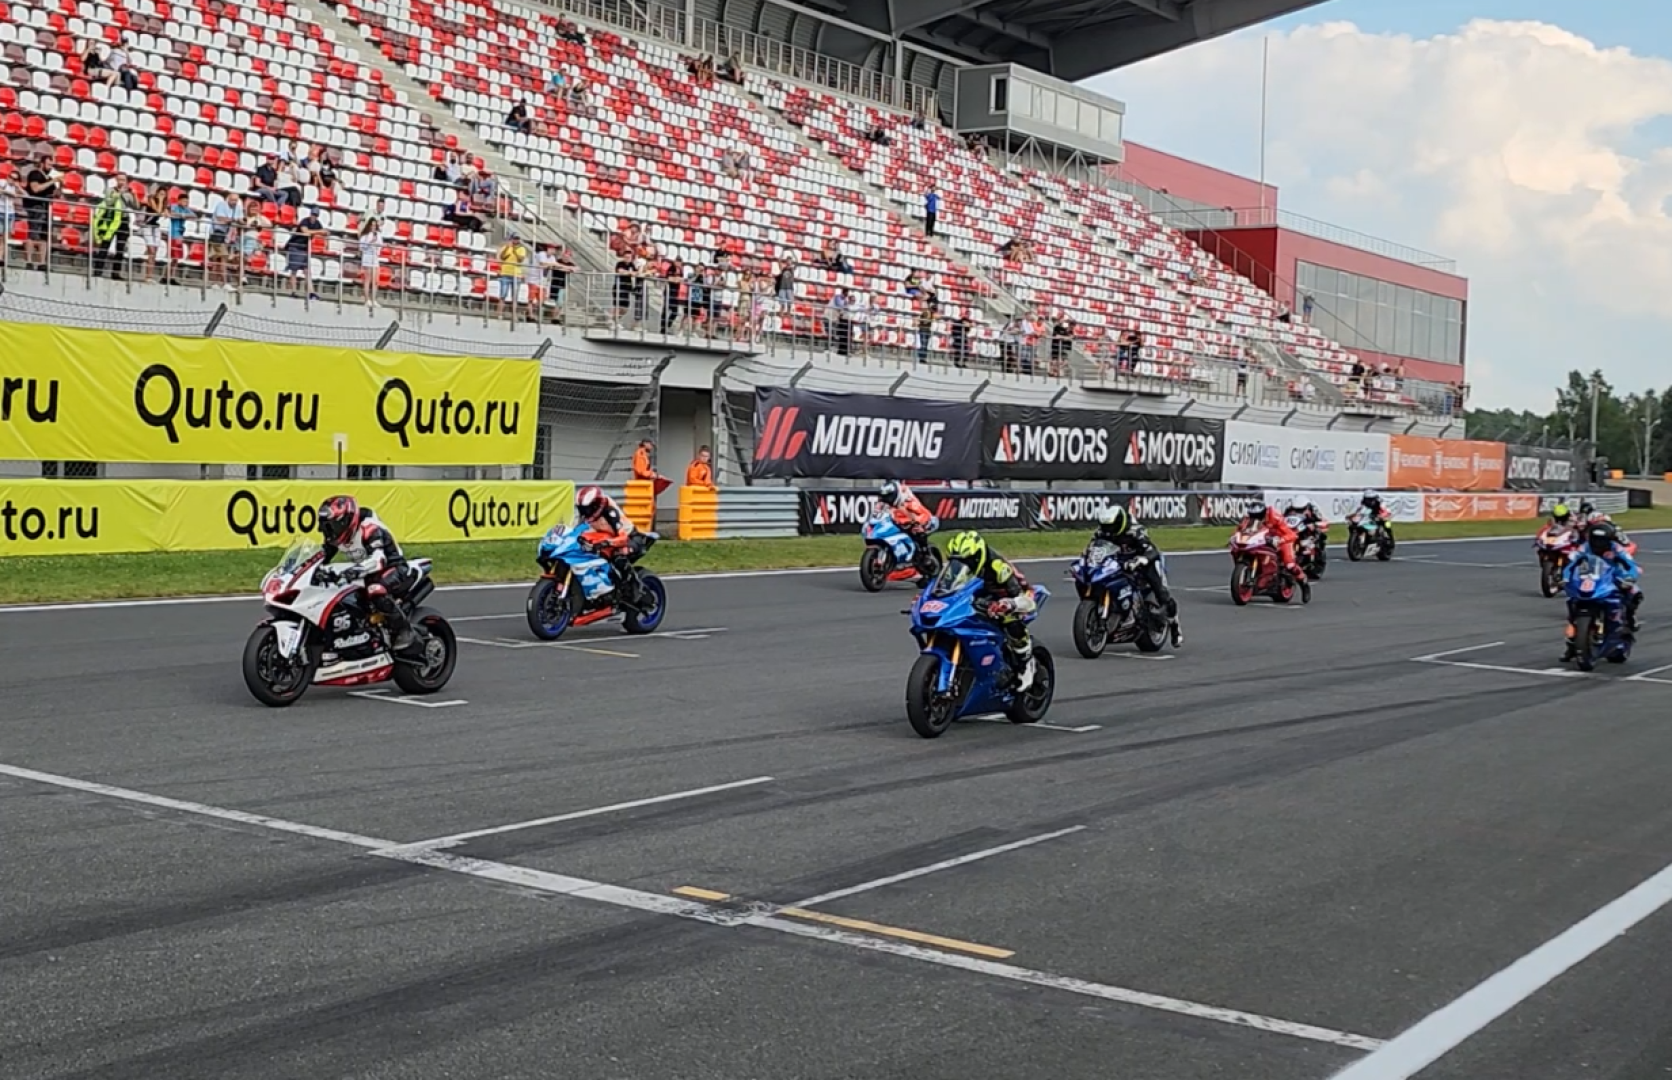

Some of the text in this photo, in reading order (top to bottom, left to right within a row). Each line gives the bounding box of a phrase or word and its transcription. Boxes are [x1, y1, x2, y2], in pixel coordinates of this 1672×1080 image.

[134, 363, 320, 443] Quto.ru
[376, 378, 520, 448] Quto.ru
[812, 414, 944, 458] MOTORING
[1023, 425, 1108, 463] MOTORS
[1147, 431, 1216, 467] MOTORS
[1, 500, 98, 540] to.ru
[227, 490, 324, 545] Quto.
[448, 489, 539, 536] Quto.ru
[839, 495, 879, 525] MOT
[958, 498, 1020, 519] MOTORING
[1142, 497, 1187, 519] MOTORS
[1214, 497, 1248, 519] MOTO
